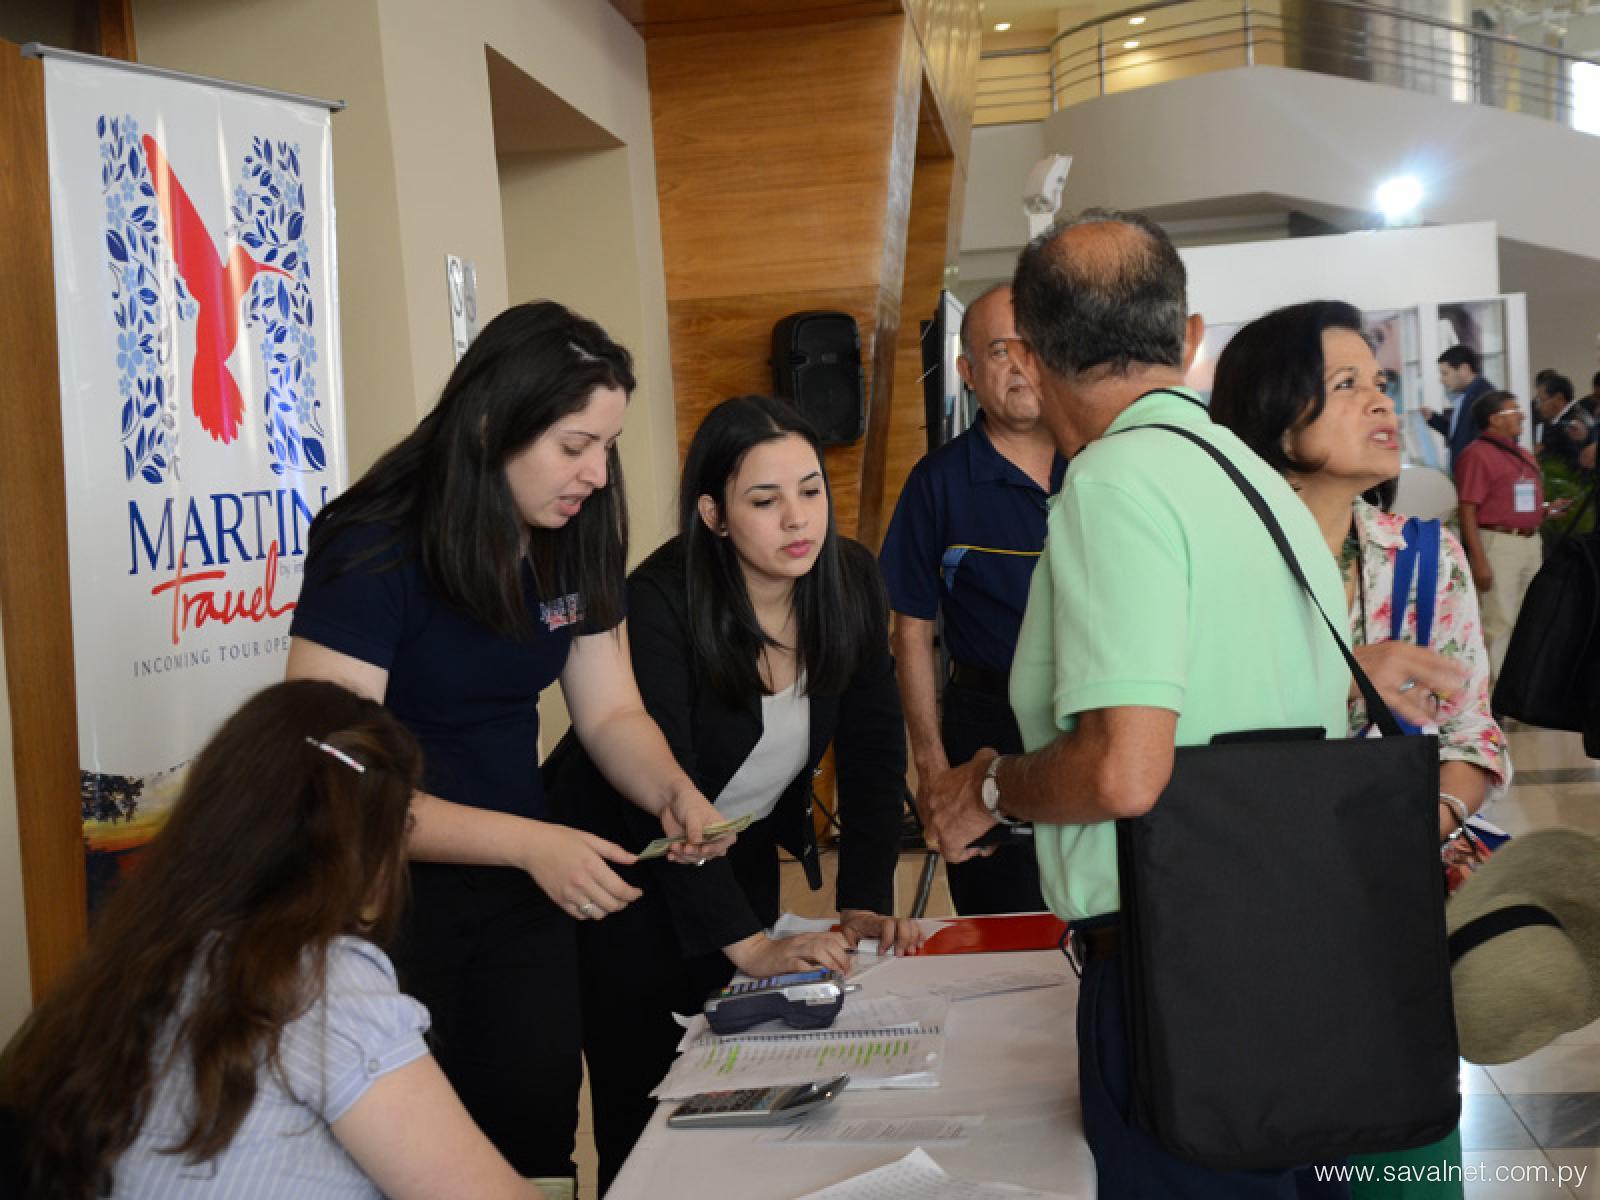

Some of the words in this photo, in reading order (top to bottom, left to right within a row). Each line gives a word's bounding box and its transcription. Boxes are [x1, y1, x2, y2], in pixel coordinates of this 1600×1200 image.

[128, 486, 328, 575] MARTIN
[133, 648, 211, 677] INCOMING
[219, 640, 260, 662] TOUR
